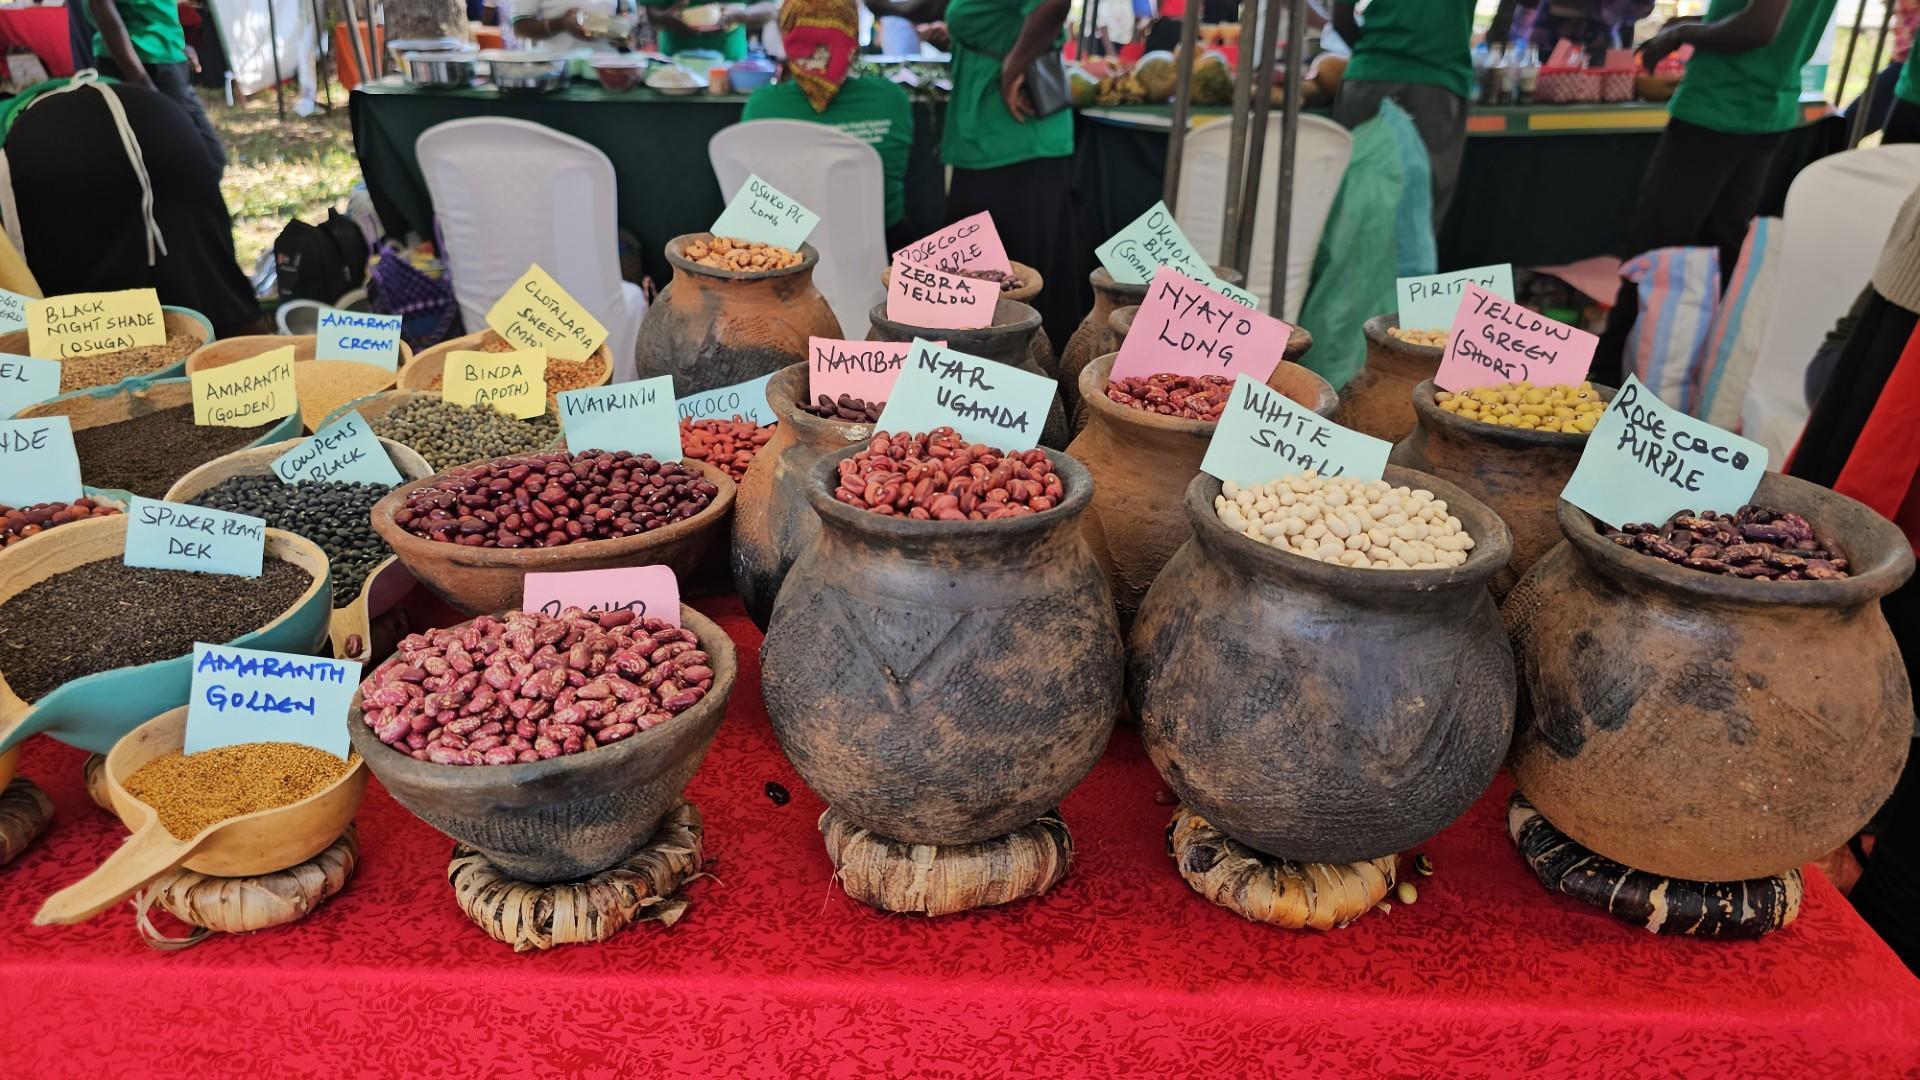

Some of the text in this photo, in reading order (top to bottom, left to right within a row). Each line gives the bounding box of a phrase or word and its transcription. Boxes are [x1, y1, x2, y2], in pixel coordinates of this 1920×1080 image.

[935, 243, 982, 270] RPLE
[899, 281, 976, 305] YELLOW
[900, 262, 971, 293] ZEBRA
[1409, 275, 1495, 303] PIRITN
[46, 300, 104, 324] BLACK
[517, 308, 566, 342] SWEET
[525, 280, 593, 349] CLOTALARIA
[1159, 282, 1251, 336] NYAYO
[1472, 292, 1572, 341] YELLOW
[60, 334, 135, 358] (OSUGA)
[338, 336, 393, 352] CREAM
[1158, 319, 1234, 367] LONG
[1451, 329, 1529, 382] (SHORT)
[1482, 323, 1558, 365] GREEN
[206, 363, 290, 401] AMARANTH
[465, 364, 523, 382] BINDA
[918, 349, 994, 391] NYAR
[207, 391, 275, 426] (GOLDEN)
[937, 386, 1029, 434] UGANDA
[1243, 383, 1332, 448] WHITE
[280, 421, 357, 480] COWPEAS
[310, 447, 366, 482] BLACK
[1617, 422, 1705, 492] PURPLE
[140, 506, 215, 535] SPIDER
[168, 537, 212, 559] DEK
[198, 650, 345, 684] AMARANTH
[206, 684, 316, 716] GOLDEN
